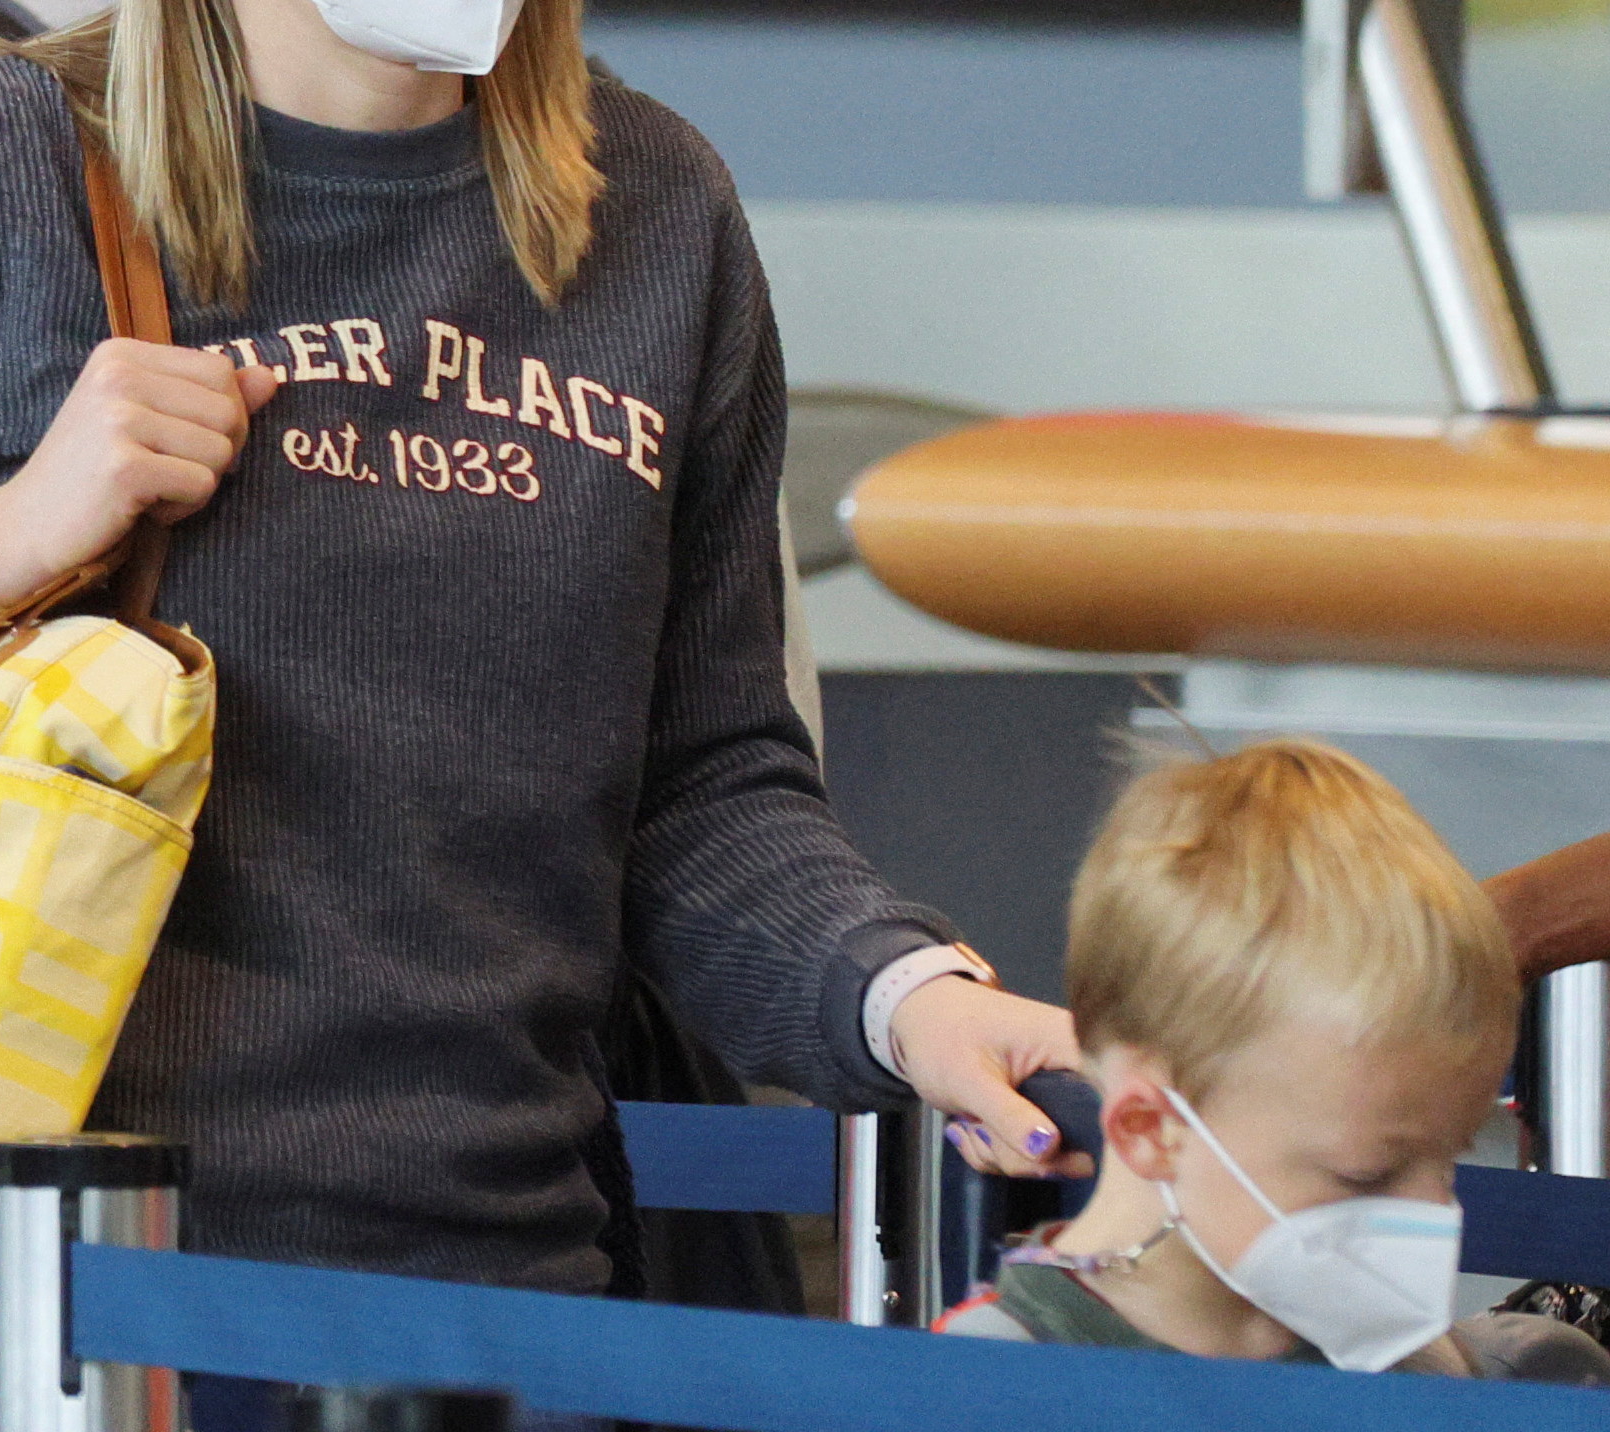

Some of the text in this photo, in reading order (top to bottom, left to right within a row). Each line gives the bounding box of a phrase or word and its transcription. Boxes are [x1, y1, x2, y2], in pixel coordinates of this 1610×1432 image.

[281, 421, 541, 502] est. 1933
[422, 317, 666, 490] PLACE
